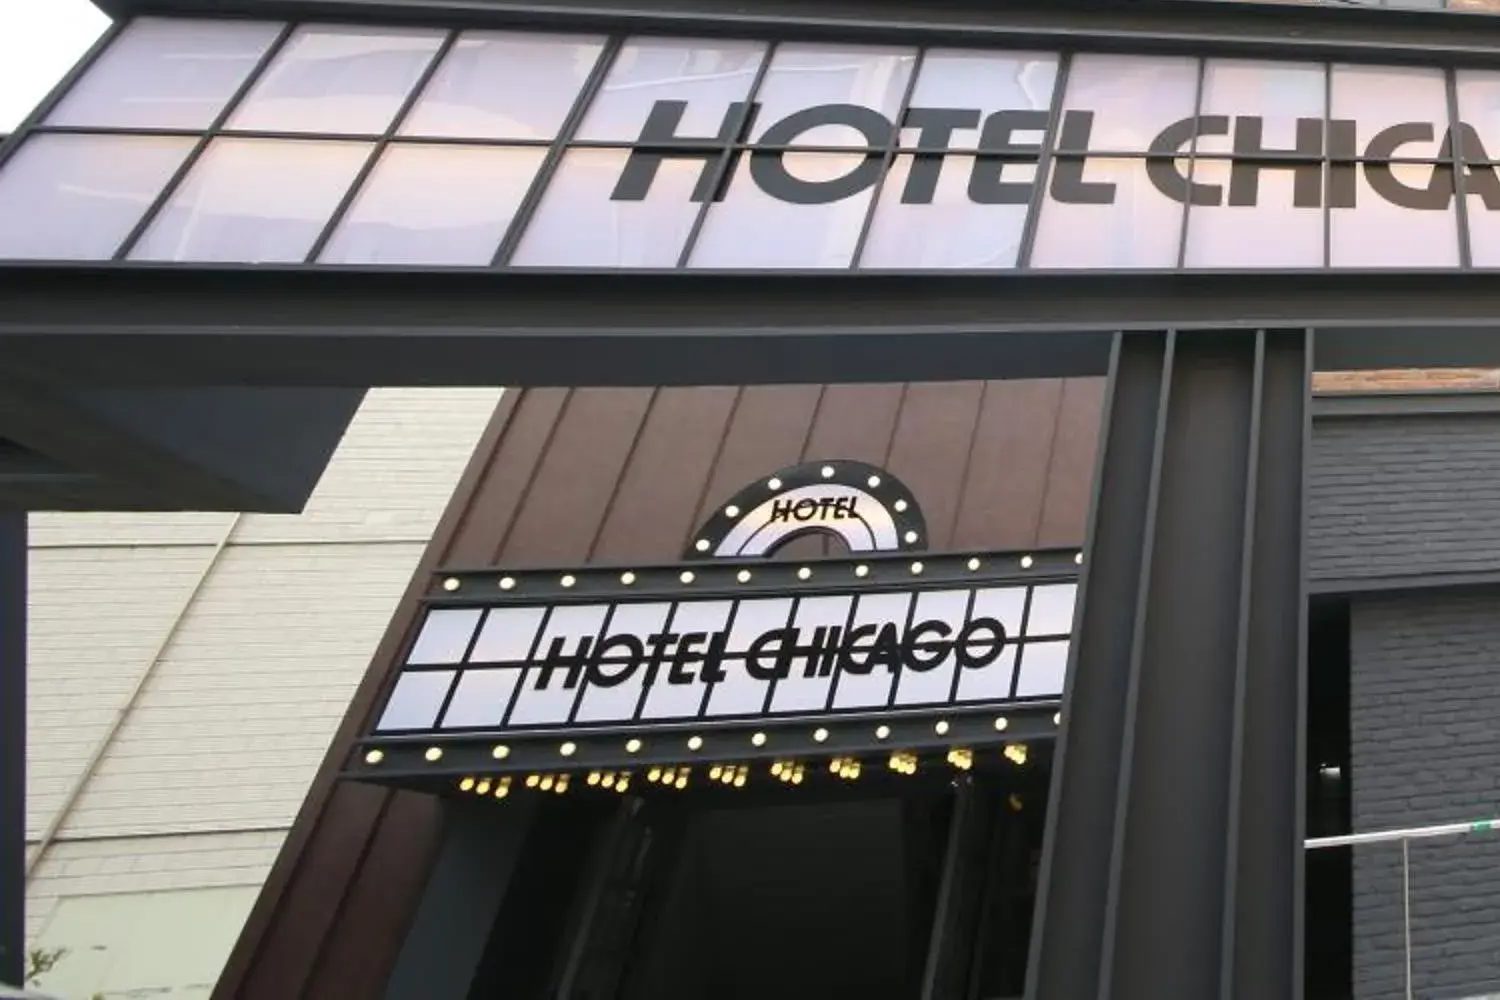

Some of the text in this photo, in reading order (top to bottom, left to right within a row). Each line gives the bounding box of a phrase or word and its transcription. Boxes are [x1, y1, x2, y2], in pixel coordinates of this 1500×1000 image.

[610, 100, 1116, 205] HOTEL
[770, 496, 858, 522] HOTEL
[535, 617, 1005, 690] HOTEL CHICAGO
